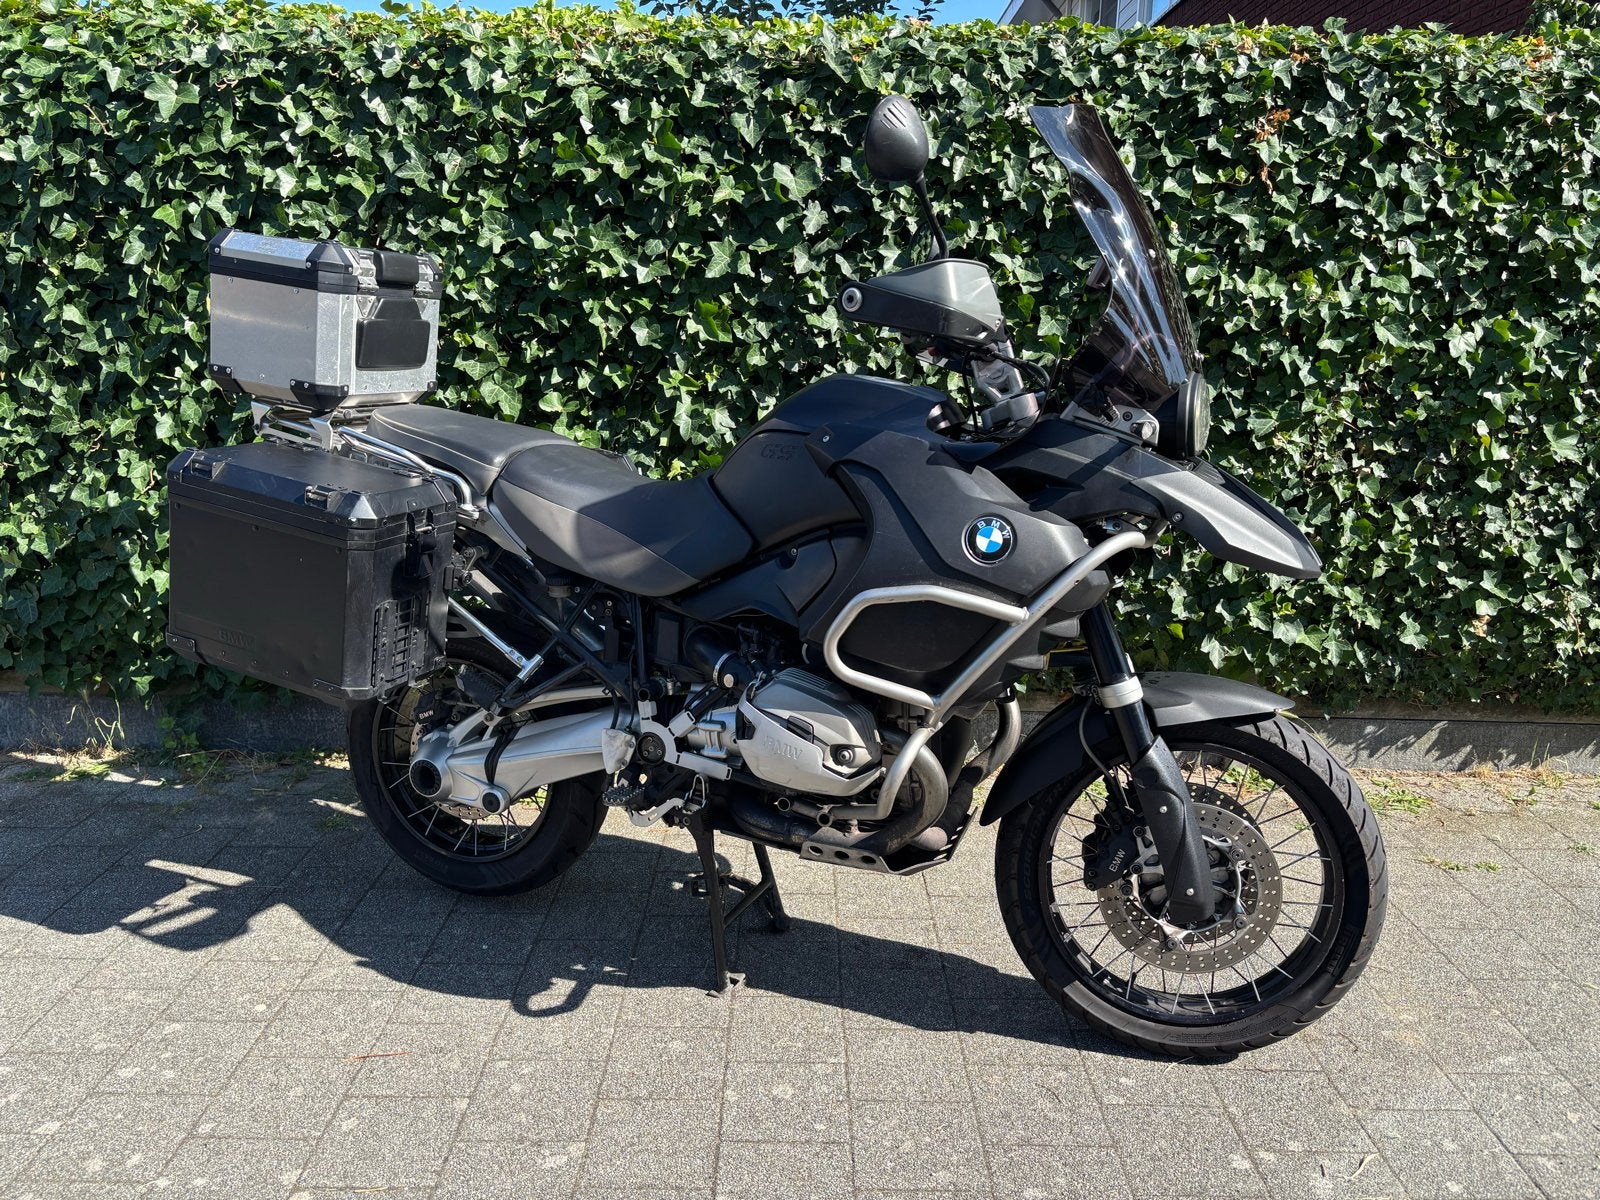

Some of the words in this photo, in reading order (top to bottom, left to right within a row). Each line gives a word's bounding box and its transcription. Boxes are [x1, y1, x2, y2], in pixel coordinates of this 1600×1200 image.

[976, 520, 1010, 539] BMW
[218, 629, 254, 649] BMW
[418, 709, 434, 720] BMW
[762, 736, 803, 760] BMW
[1108, 848, 1126, 872] BMW
